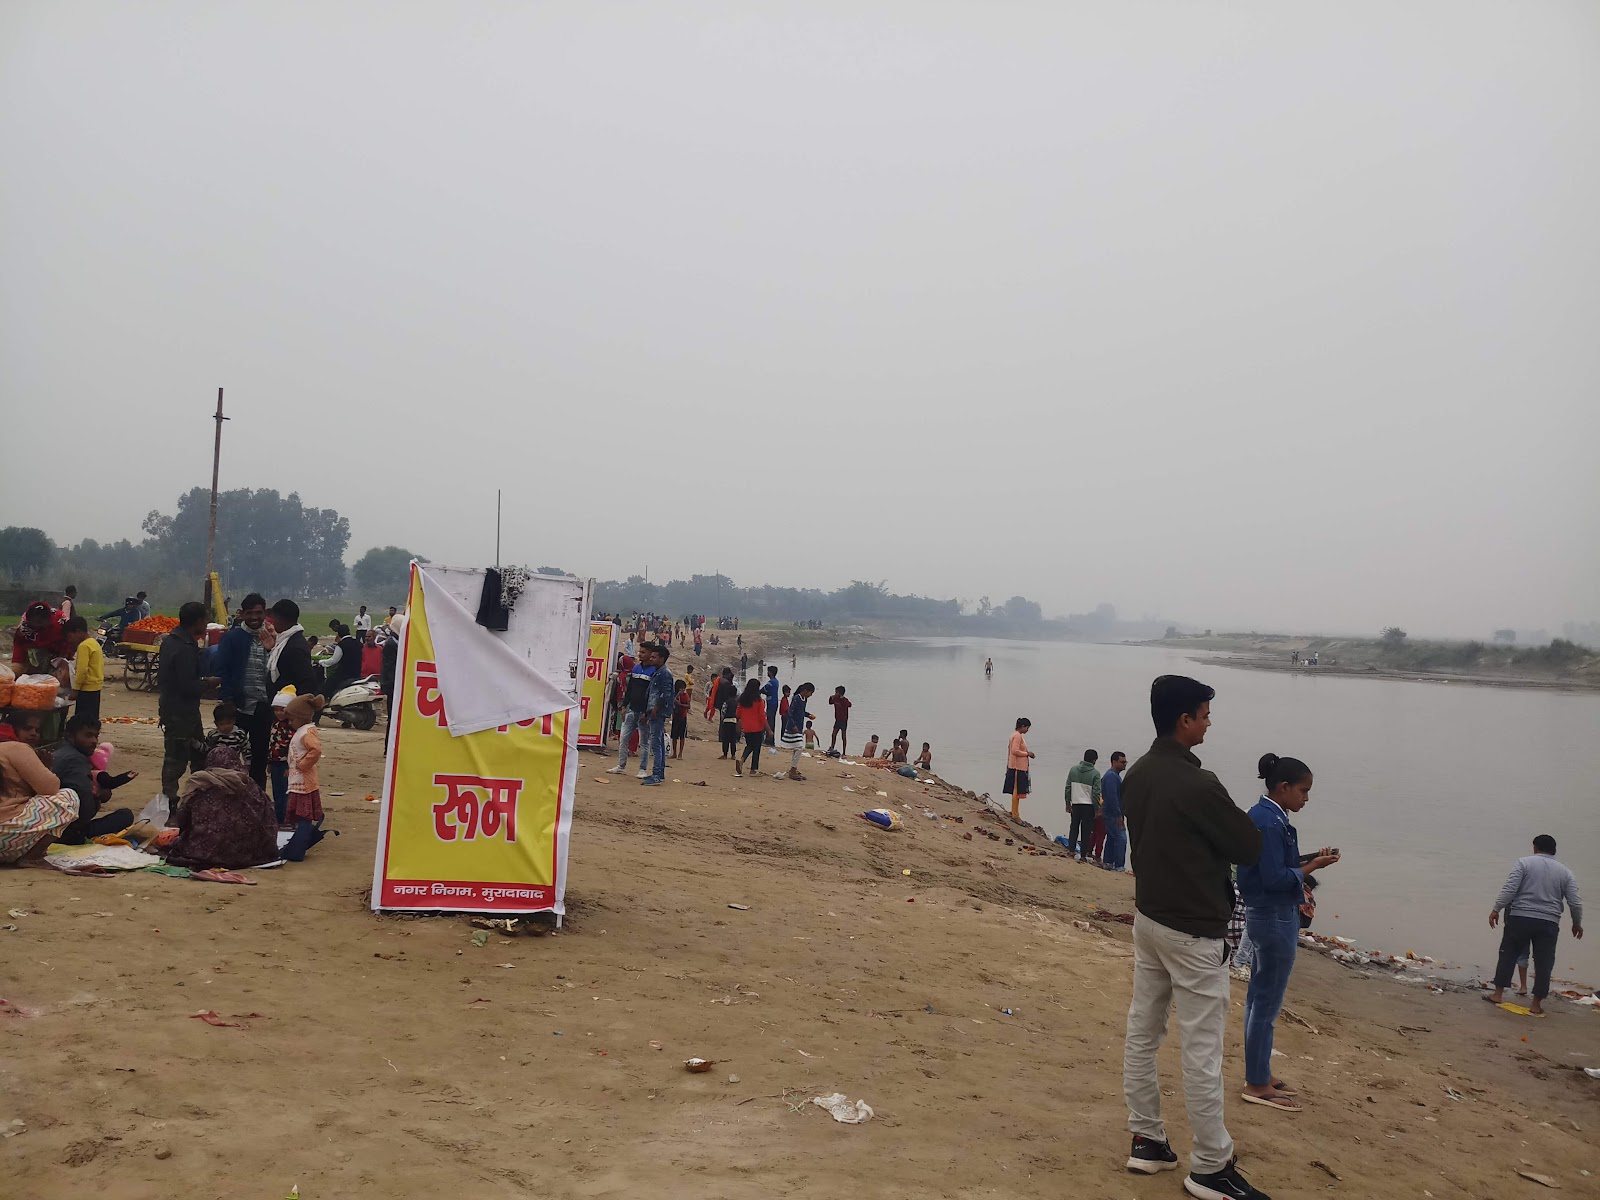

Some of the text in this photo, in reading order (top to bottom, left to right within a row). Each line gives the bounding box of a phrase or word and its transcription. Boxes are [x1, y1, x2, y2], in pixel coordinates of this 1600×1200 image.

[433, 774, 524, 842] रूम
[394, 883, 545, 902] नगर निगम, मुरादाबाद
